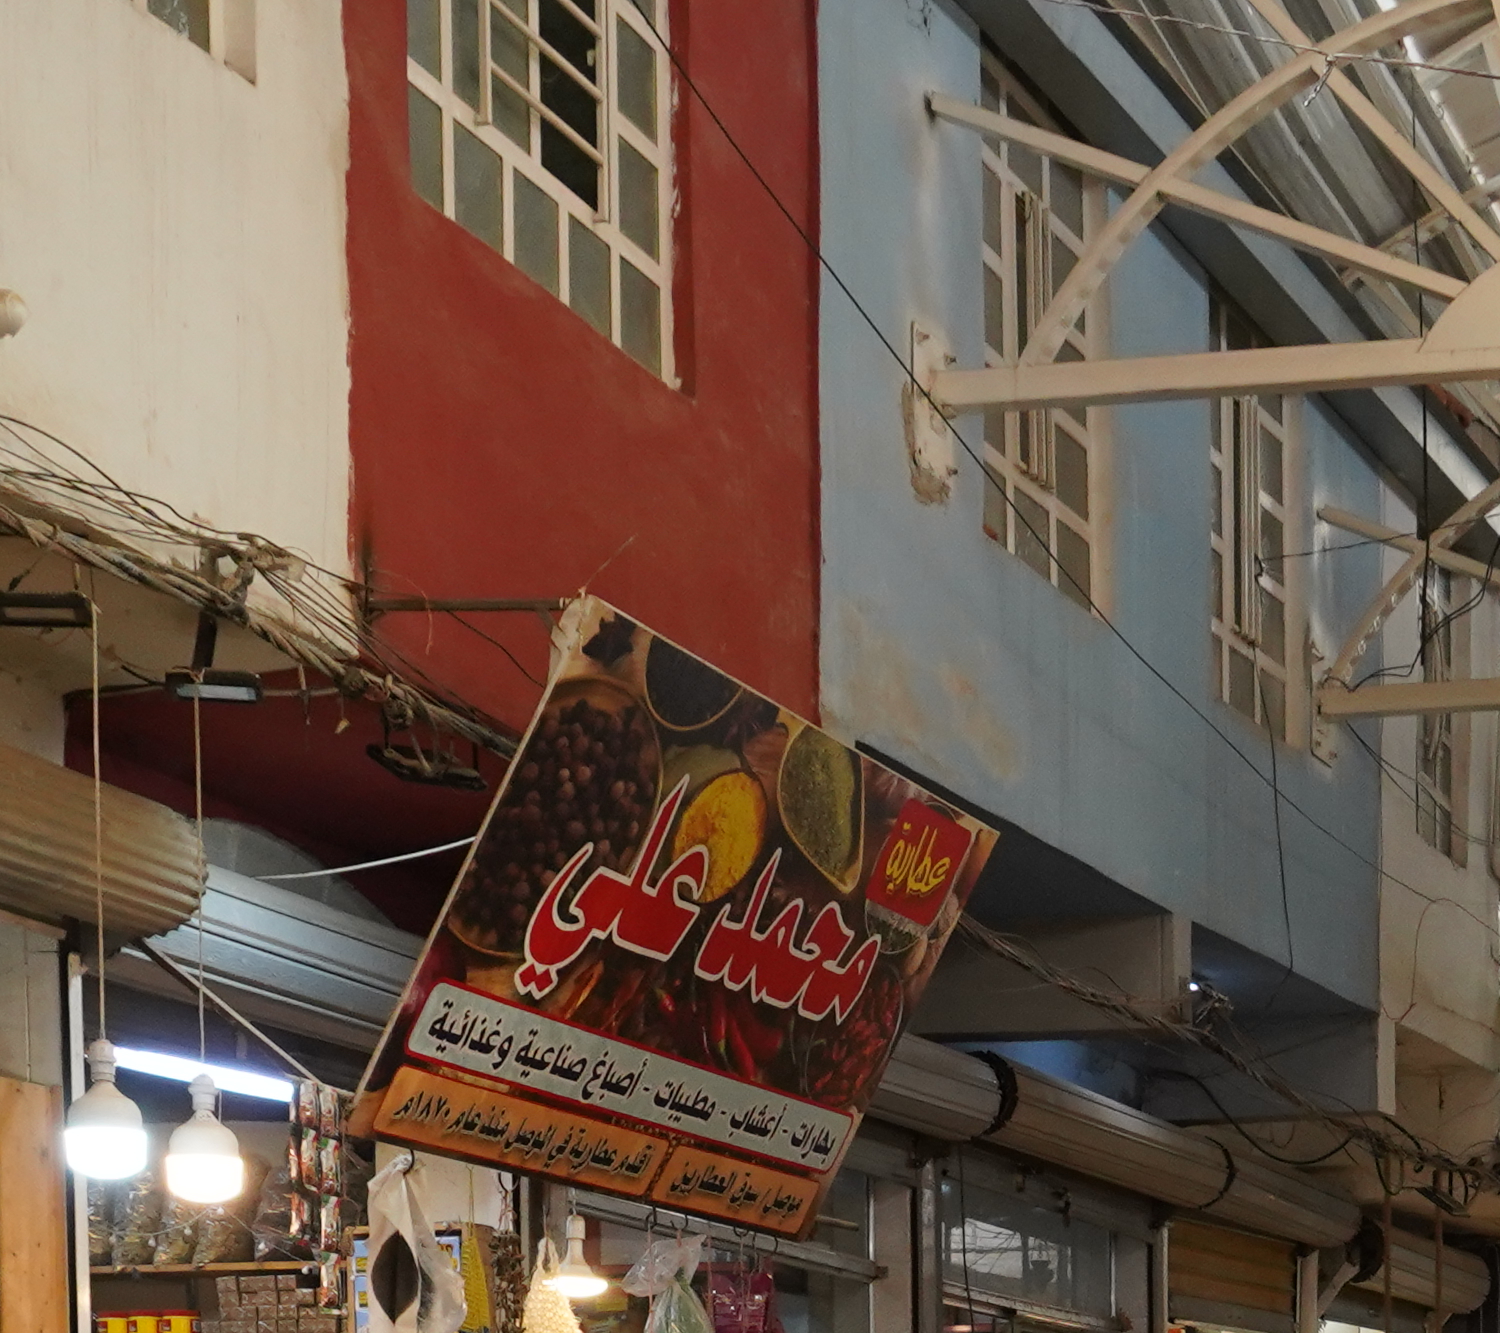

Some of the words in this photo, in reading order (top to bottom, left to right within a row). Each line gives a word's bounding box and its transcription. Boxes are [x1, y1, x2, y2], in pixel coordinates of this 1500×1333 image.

[514, 772, 708, 998] علي
[695, 847, 882, 1025] محمد
[514, 1028, 588, 1082] صناعية
[729, 1103, 787, 1141] أعشاب
[790, 1122, 836, 1164] بهارات
